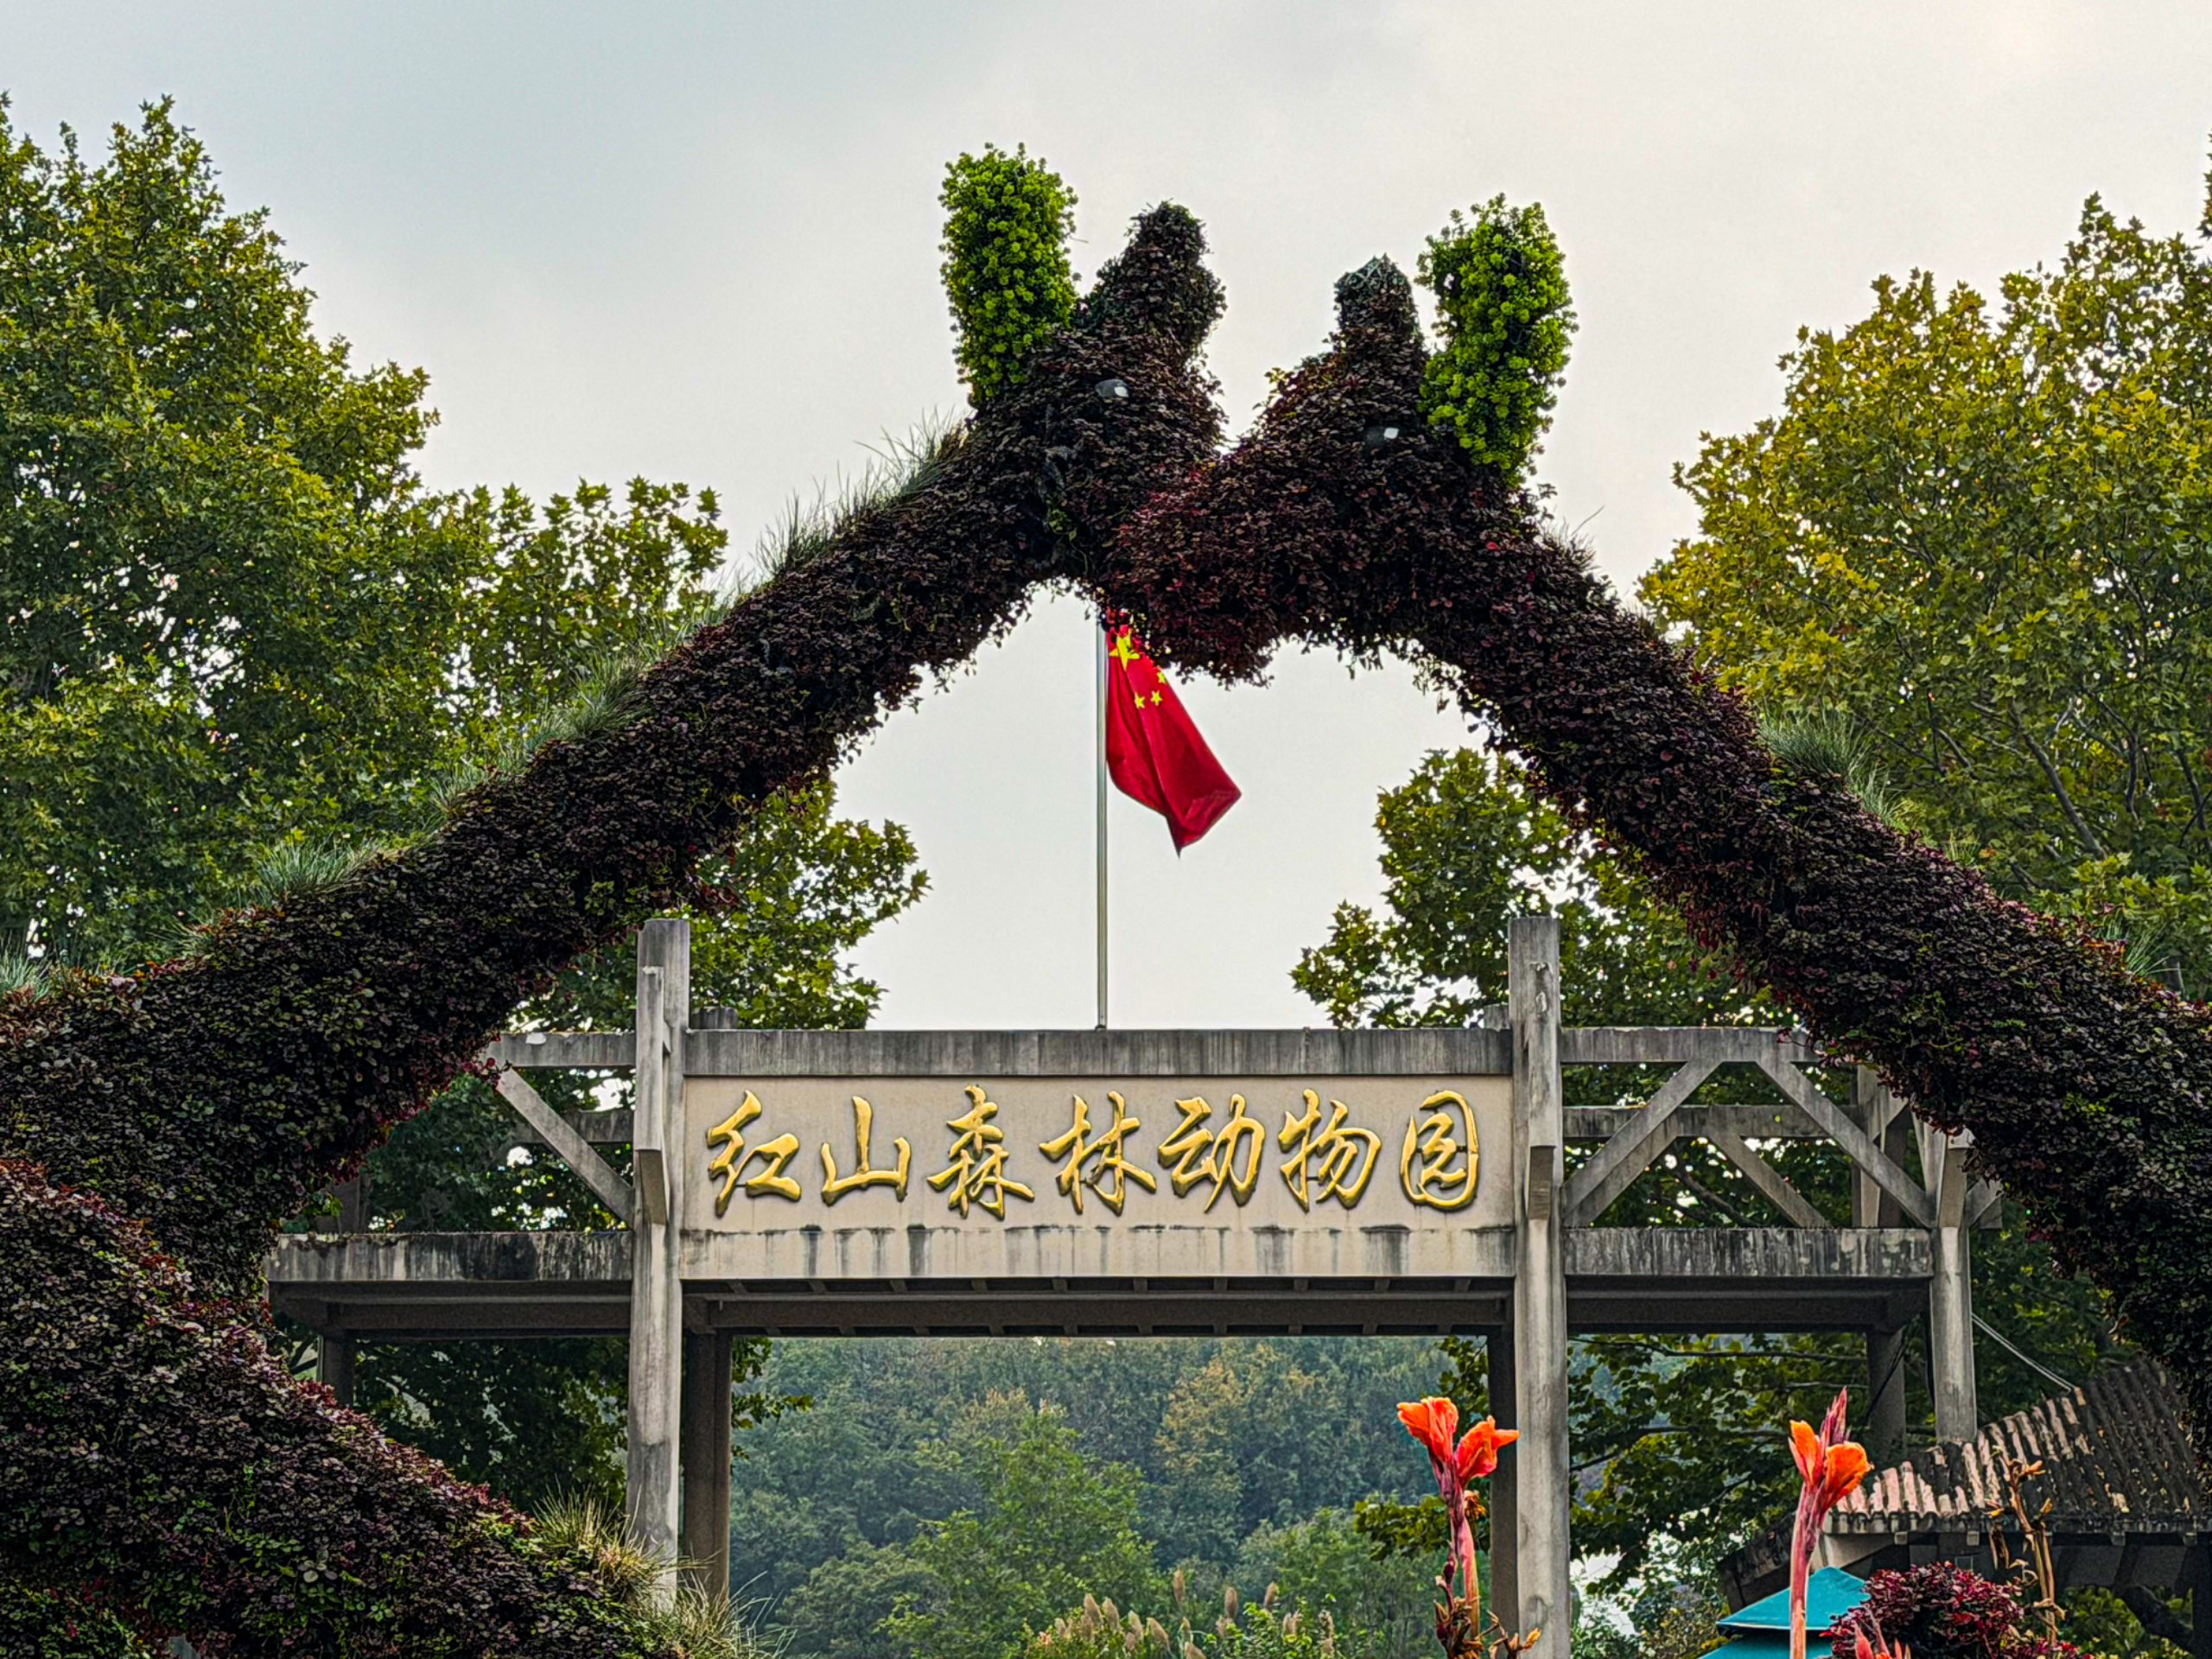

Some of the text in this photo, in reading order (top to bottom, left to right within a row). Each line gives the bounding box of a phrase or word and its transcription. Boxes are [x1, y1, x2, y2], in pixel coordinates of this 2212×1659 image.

[706, 1084, 1480, 1219] 红山森林动物园
